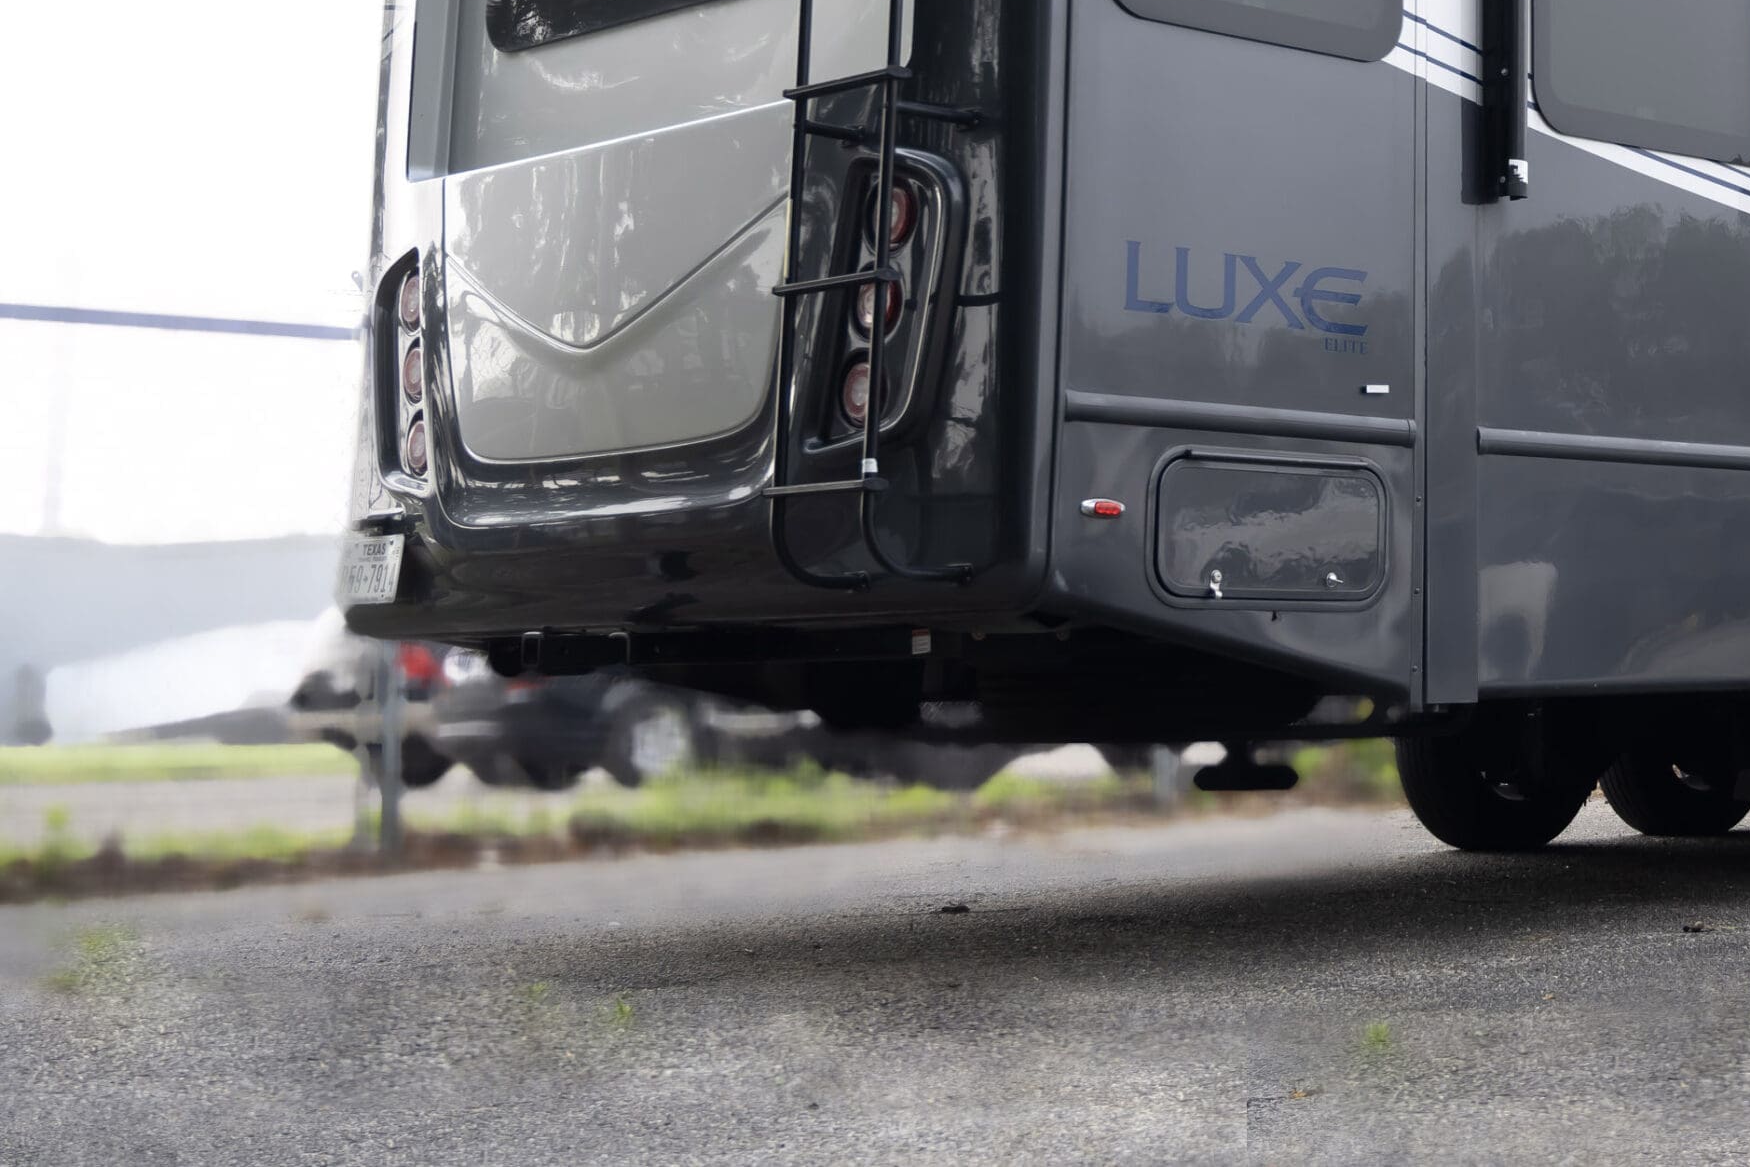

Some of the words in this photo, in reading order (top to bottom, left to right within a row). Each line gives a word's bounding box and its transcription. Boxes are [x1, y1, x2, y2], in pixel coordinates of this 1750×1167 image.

[1124, 240, 1368, 336] LUXE
[1324, 336, 1368, 354] ELITE
[362, 542, 387, 556] TEXAS
